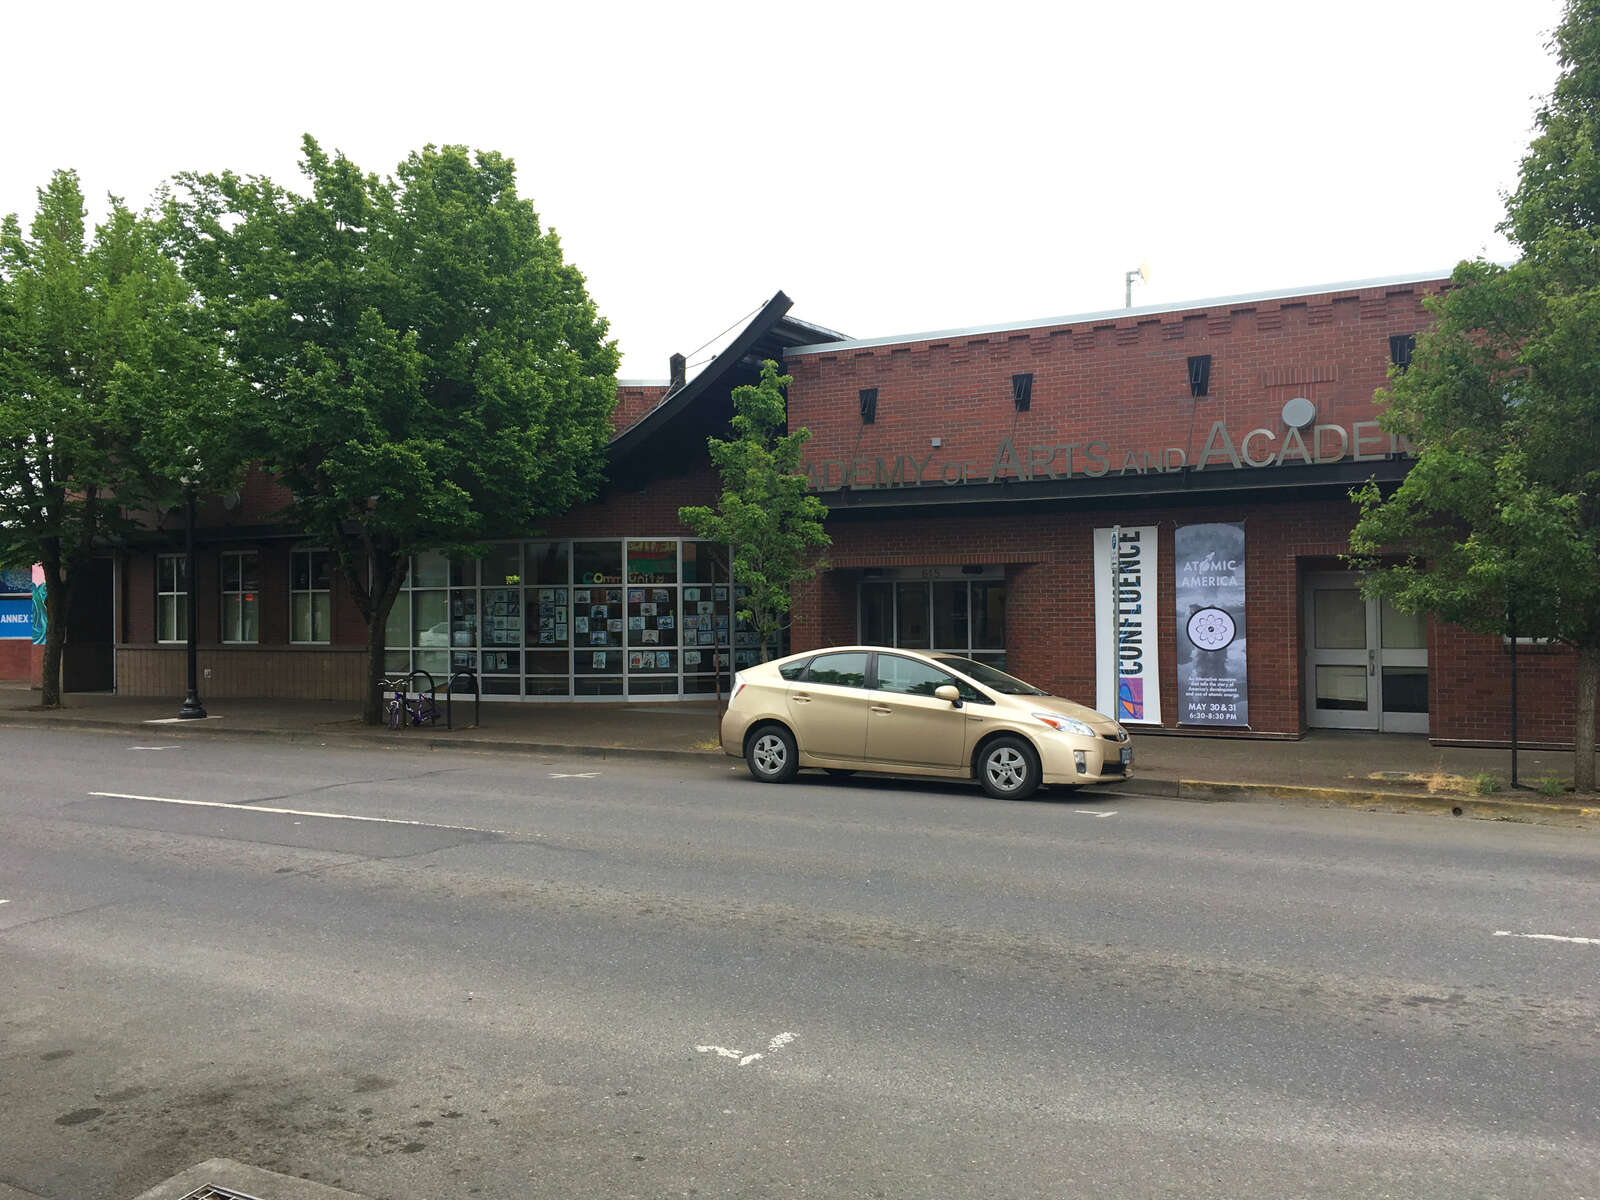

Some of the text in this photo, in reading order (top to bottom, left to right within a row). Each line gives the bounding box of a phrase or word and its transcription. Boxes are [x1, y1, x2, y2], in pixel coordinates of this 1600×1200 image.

[941, 461, 977, 485] OF
[987, 437, 1110, 483] ARTS
[1120, 448, 1186, 475] AND
[1183, 559, 1237, 572] ATOMIC
[1181, 576, 1239, 587] AMERICA
[1113, 531, 1143, 675] CONFLUENCE
[0, 614, 29, 624] ANNEX
[1188, 703, 1237, 712] MAY 30 & 31
[1226, 713, 1238, 721] PM
